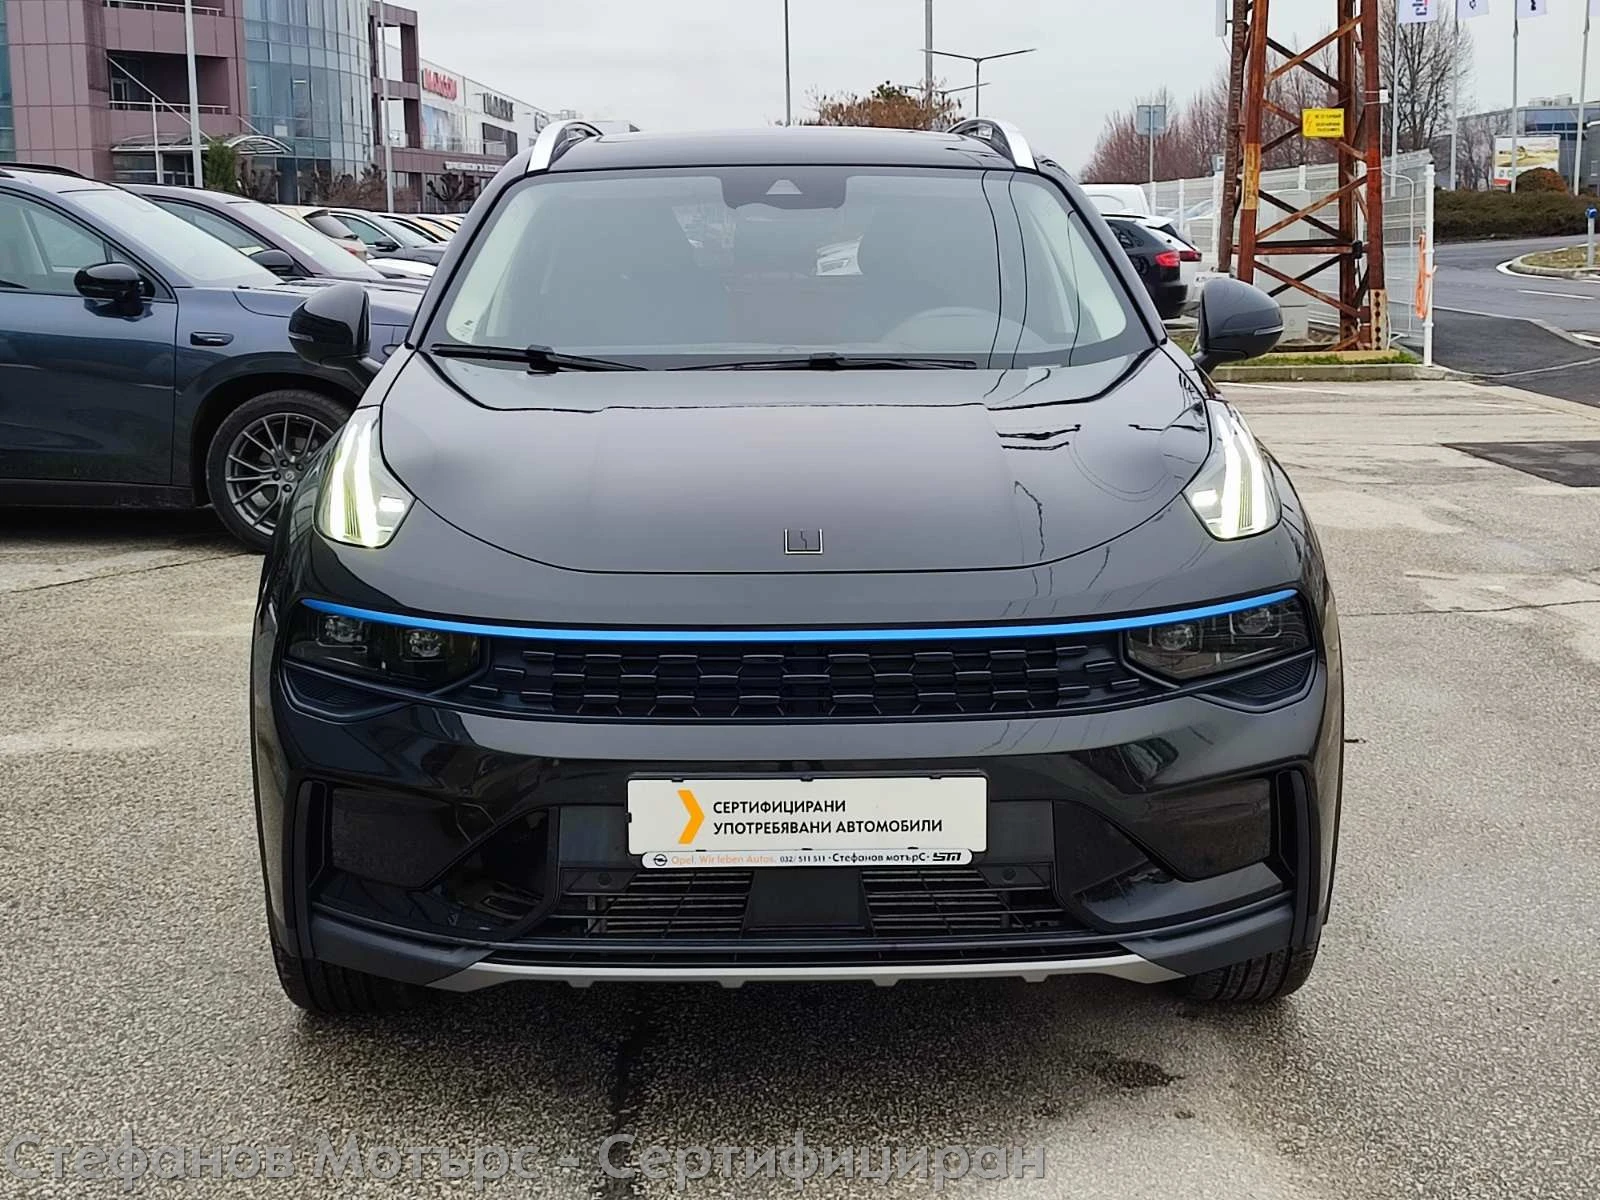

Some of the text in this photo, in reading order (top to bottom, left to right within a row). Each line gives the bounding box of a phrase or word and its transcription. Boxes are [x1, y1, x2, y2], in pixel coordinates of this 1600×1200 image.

[713, 800, 846, 815] СЕРТИФИЦИРАНИ
[713, 819, 942, 835] УПОТРЕБЯВАНИ АВТОМОБИЛИ
[717, 854, 743, 864] leben
[832, 852, 884, 864] Стефанов
